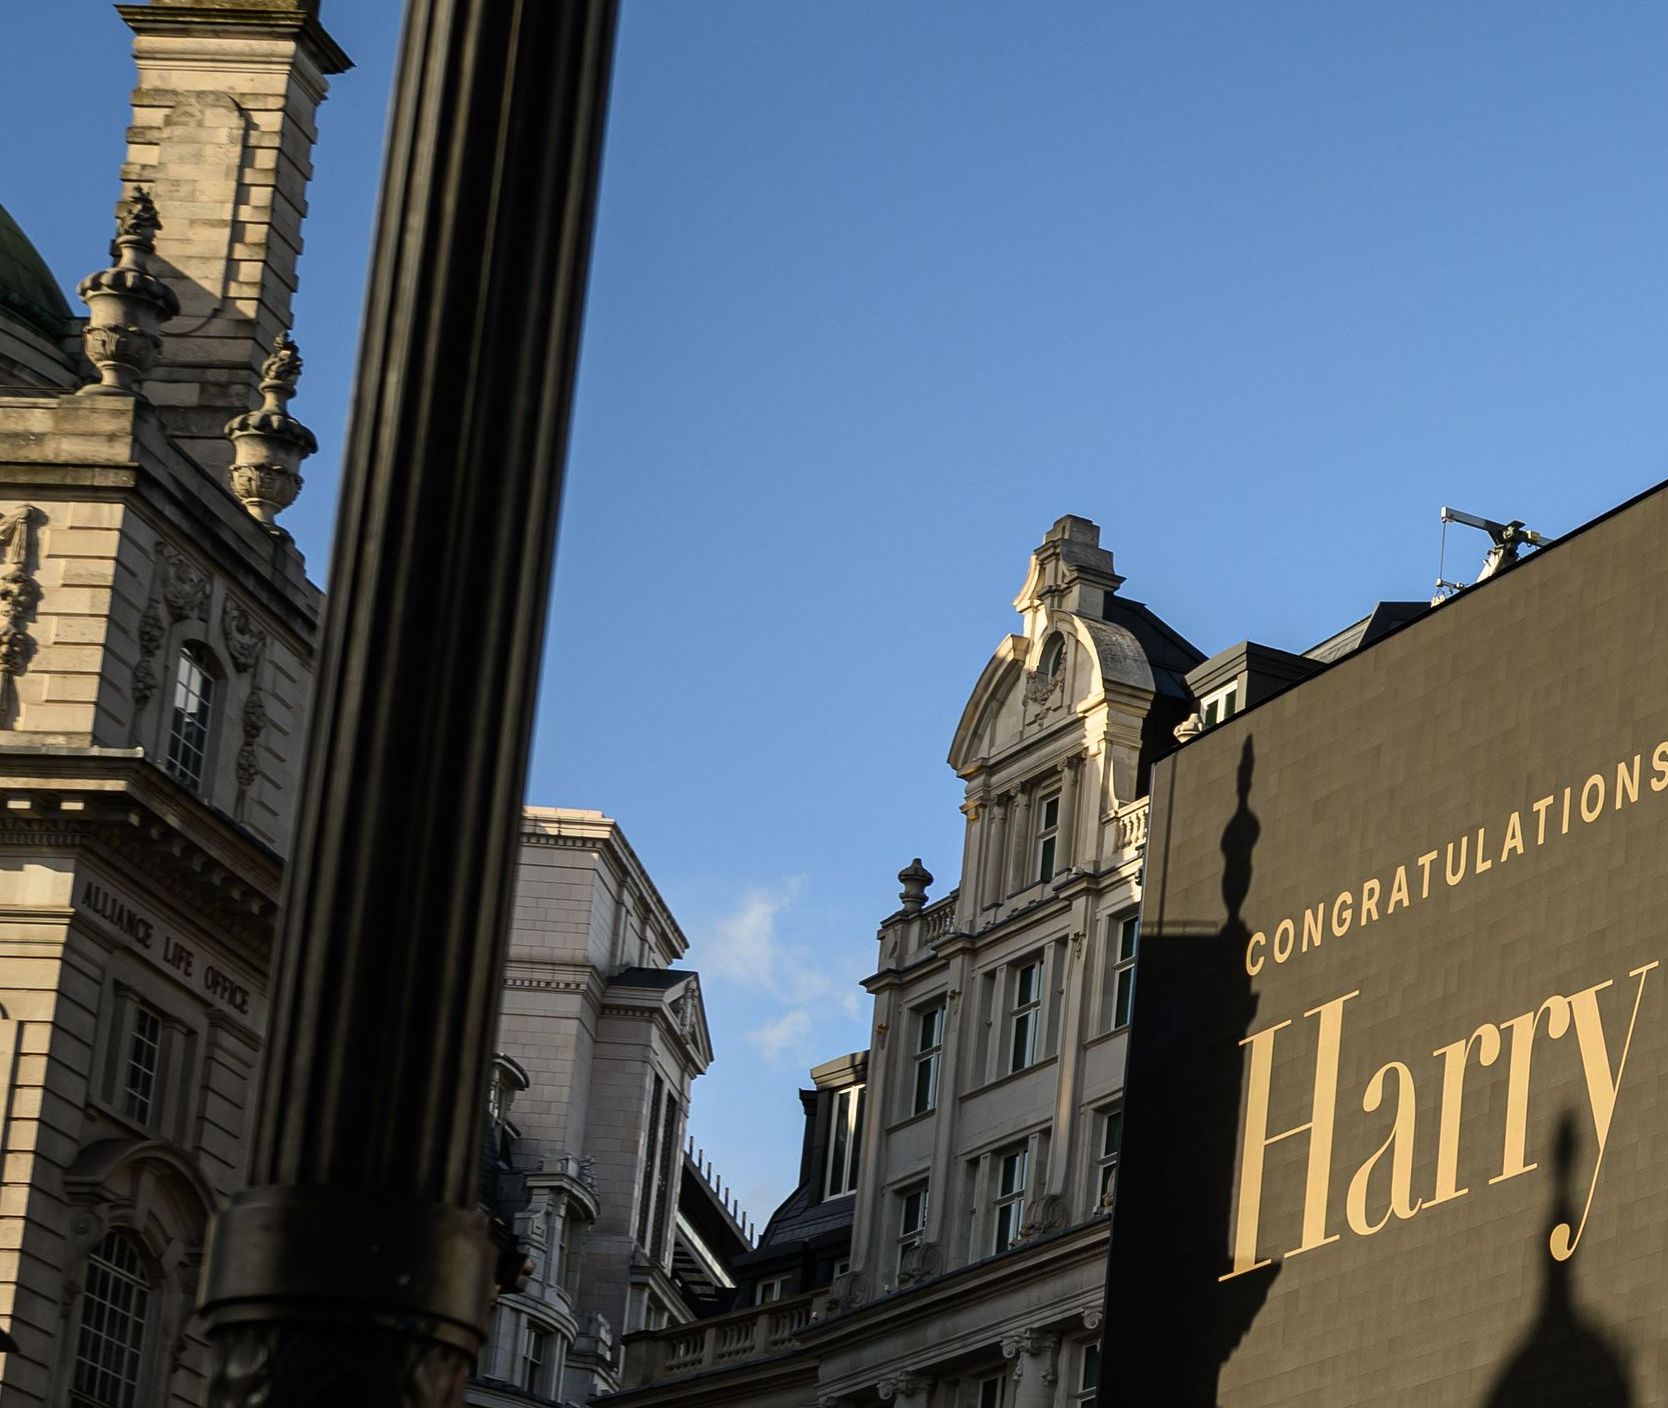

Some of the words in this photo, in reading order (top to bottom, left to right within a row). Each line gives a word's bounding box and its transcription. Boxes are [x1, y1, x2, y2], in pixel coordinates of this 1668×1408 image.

[82, 881, 154, 950] ALLIANCE
[162, 936, 195, 978] LIFE
[204, 965, 250, 1015] OFFICE
[1218, 959, 1660, 1282] Harry
